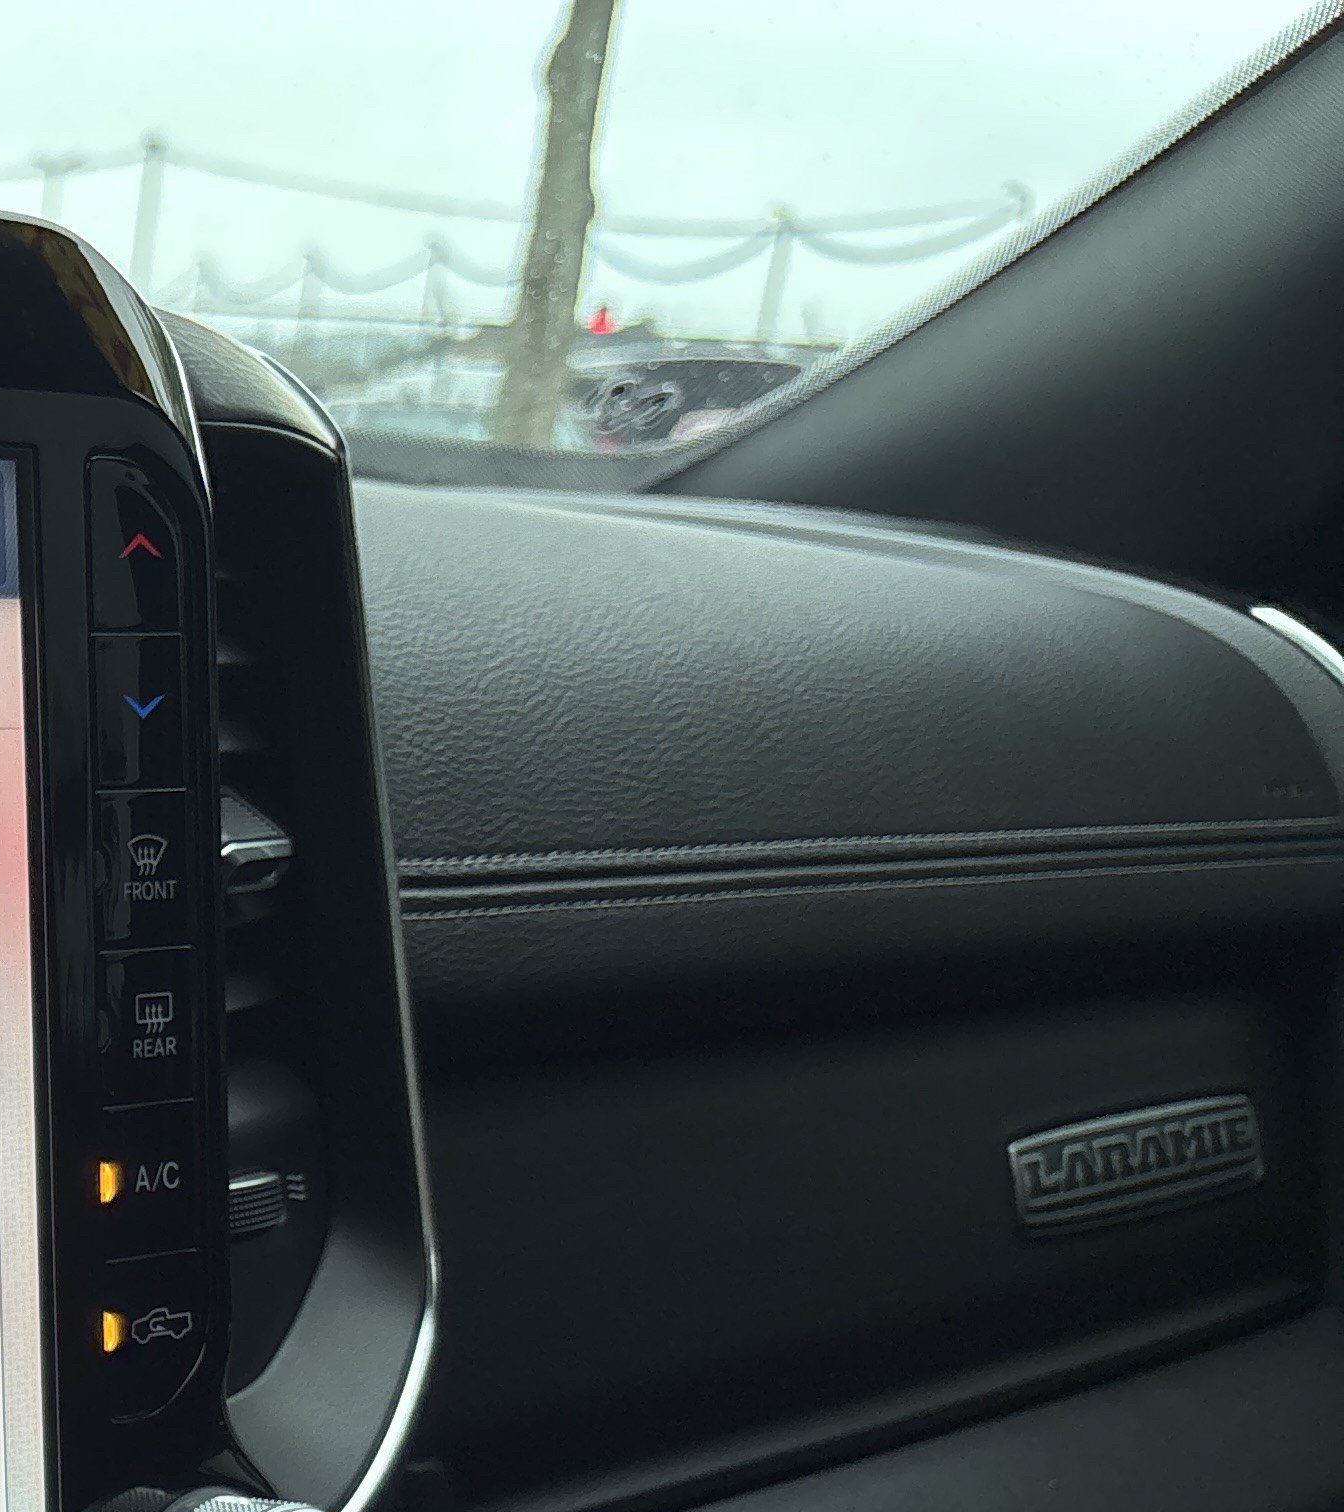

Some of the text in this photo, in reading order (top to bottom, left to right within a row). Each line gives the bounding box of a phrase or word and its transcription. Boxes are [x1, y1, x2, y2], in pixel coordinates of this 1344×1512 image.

[123, 879, 177, 901] FRONT
[132, 1036, 178, 1059] REAR
[134, 1160, 180, 1193] A/C
